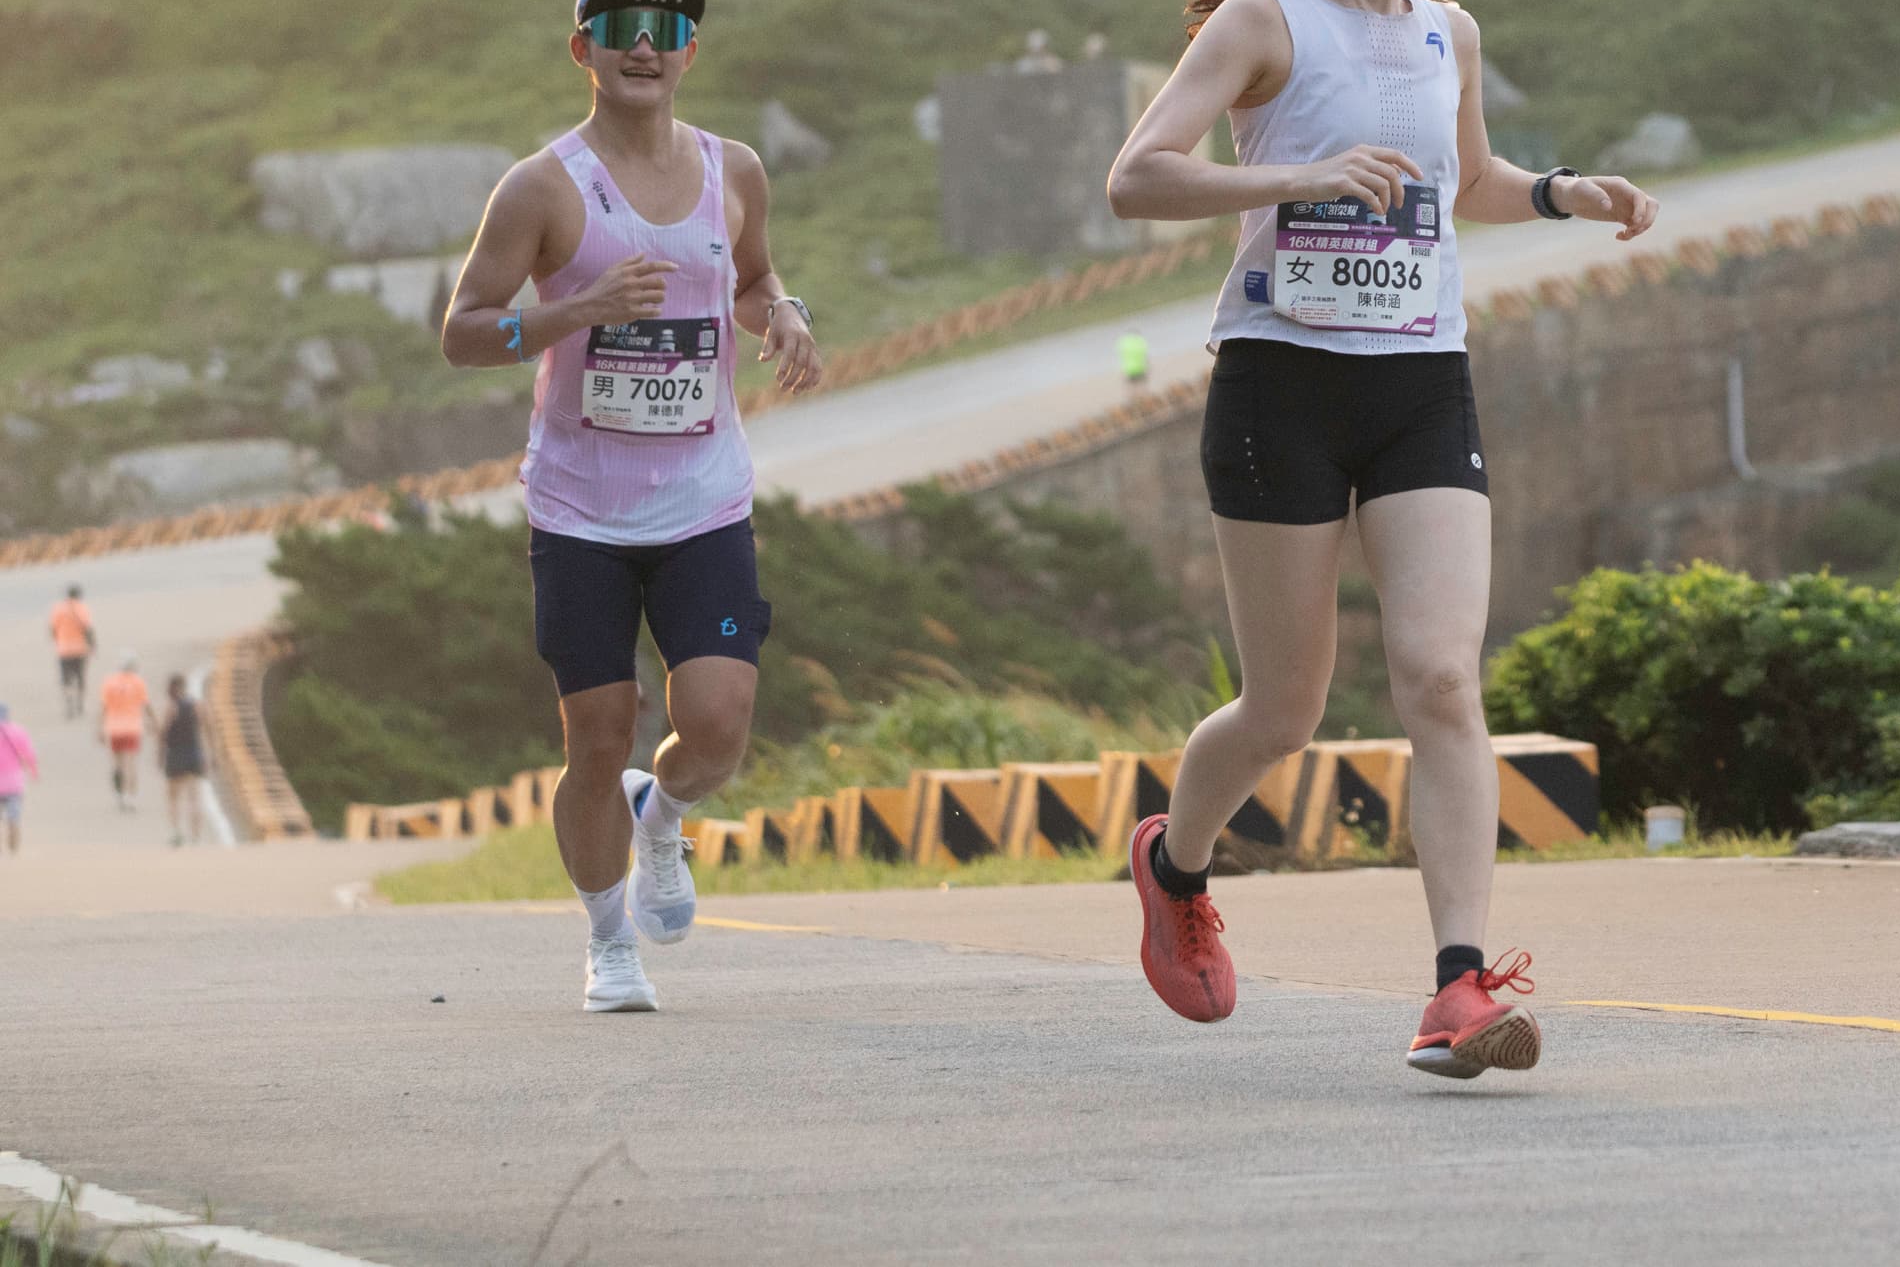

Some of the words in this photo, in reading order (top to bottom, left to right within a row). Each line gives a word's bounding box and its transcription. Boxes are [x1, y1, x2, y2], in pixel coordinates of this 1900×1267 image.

[1286, 256, 1315, 285] 女
[1332, 257, 1422, 290] 80036
[1357, 292, 1401, 309] 陳倚涵
[592, 375, 614, 398] 男
[630, 378, 703, 401] 70076
